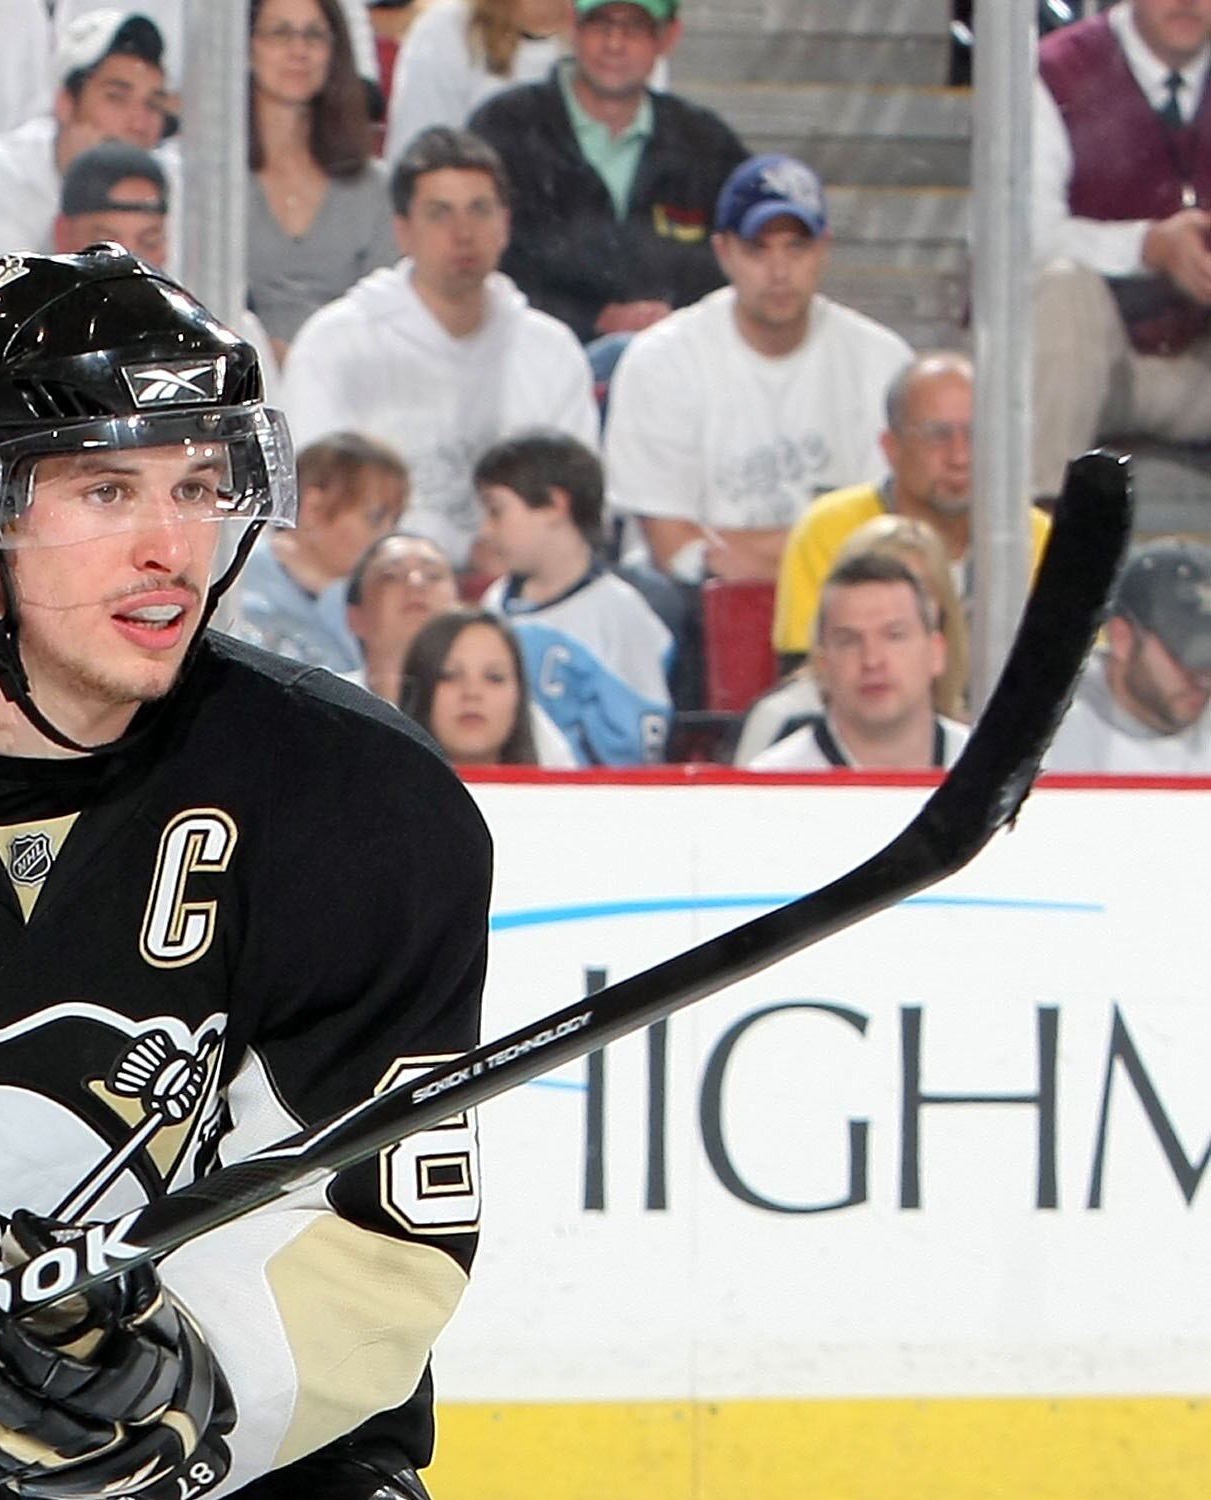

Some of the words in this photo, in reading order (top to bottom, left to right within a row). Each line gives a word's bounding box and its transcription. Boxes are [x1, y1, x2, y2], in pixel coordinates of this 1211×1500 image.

[17, 843, 45, 875] NHL
[140, 808, 238, 969] C
[485, 1010, 593, 1068] TECHNOLOGY
[177, 1462, 215, 1500] 87
